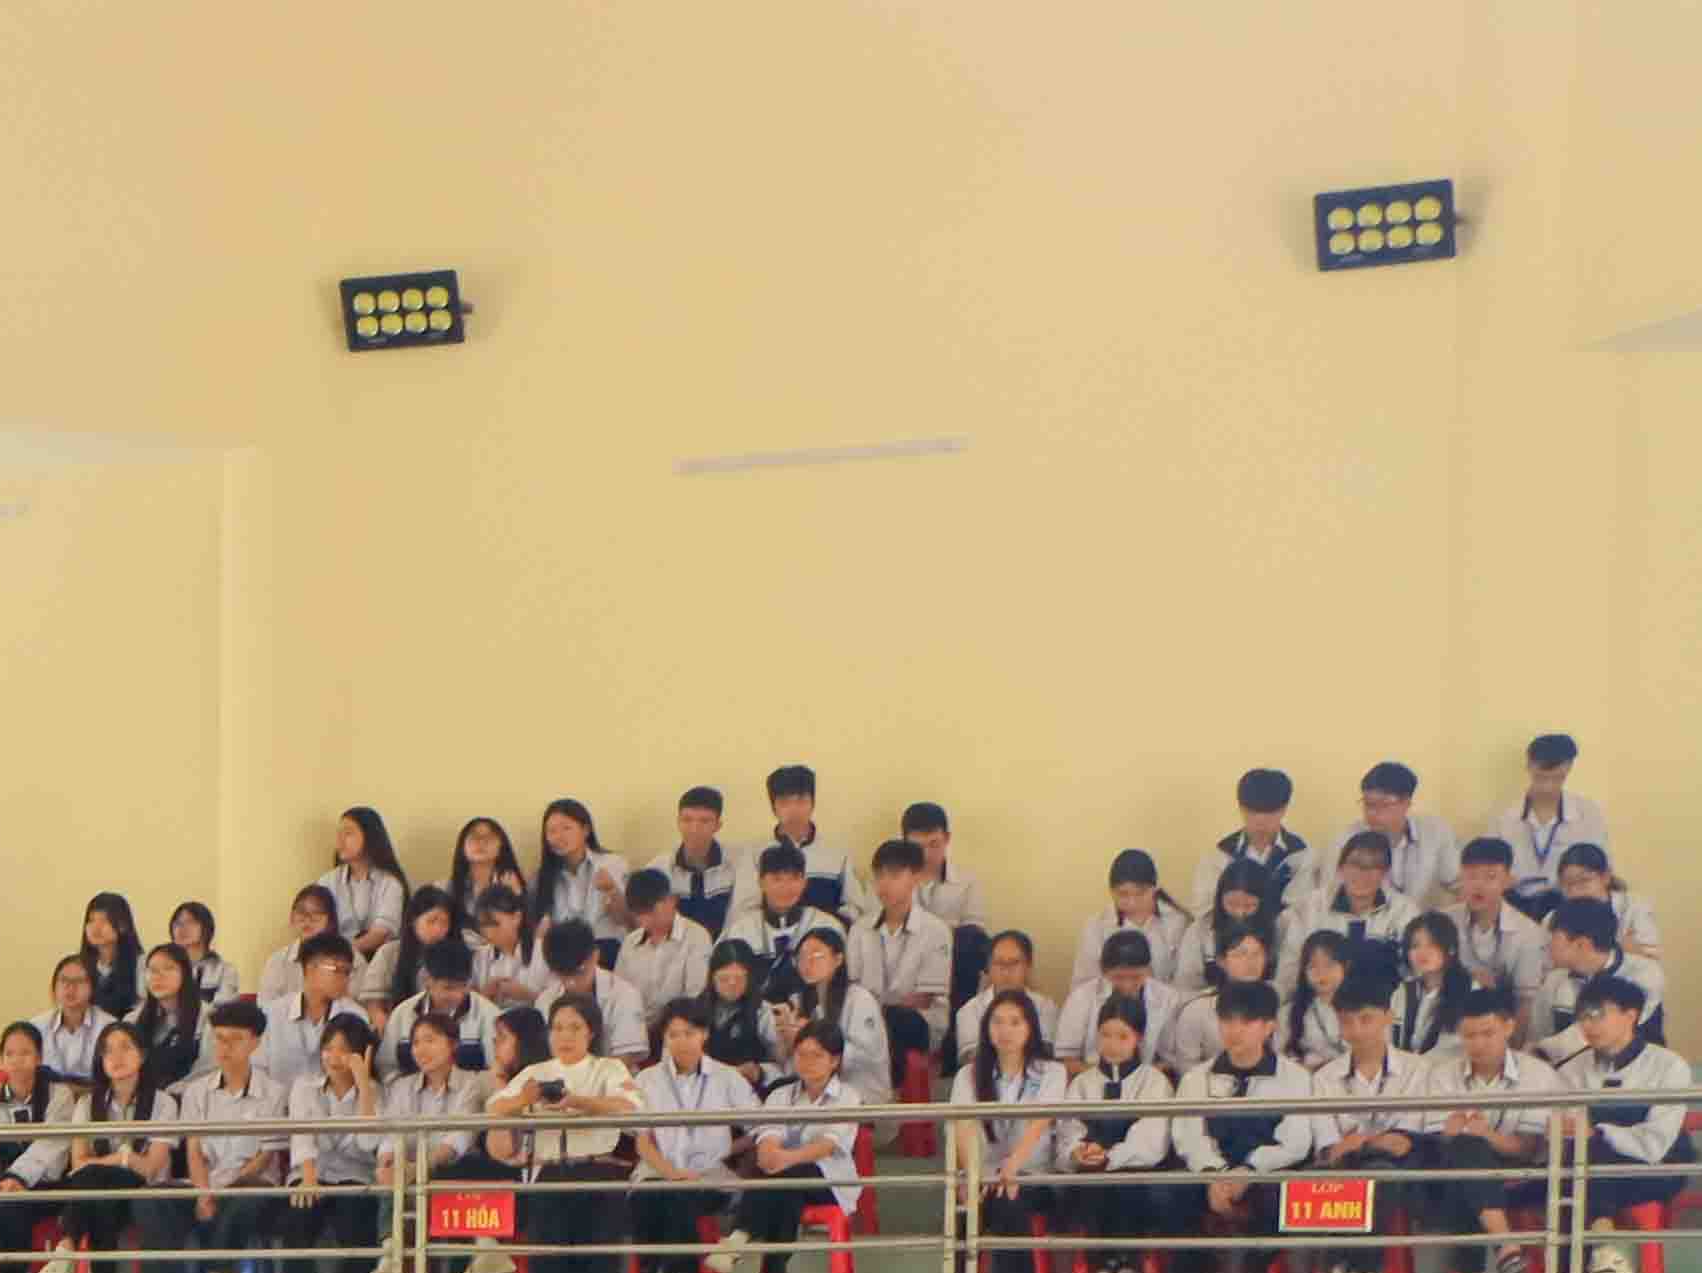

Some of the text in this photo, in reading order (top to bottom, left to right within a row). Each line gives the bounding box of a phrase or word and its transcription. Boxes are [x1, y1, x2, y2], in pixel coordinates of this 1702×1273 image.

[442, 1203, 501, 1229] 11 HÓA
[1292, 1200, 1362, 1219] 11 ANH
